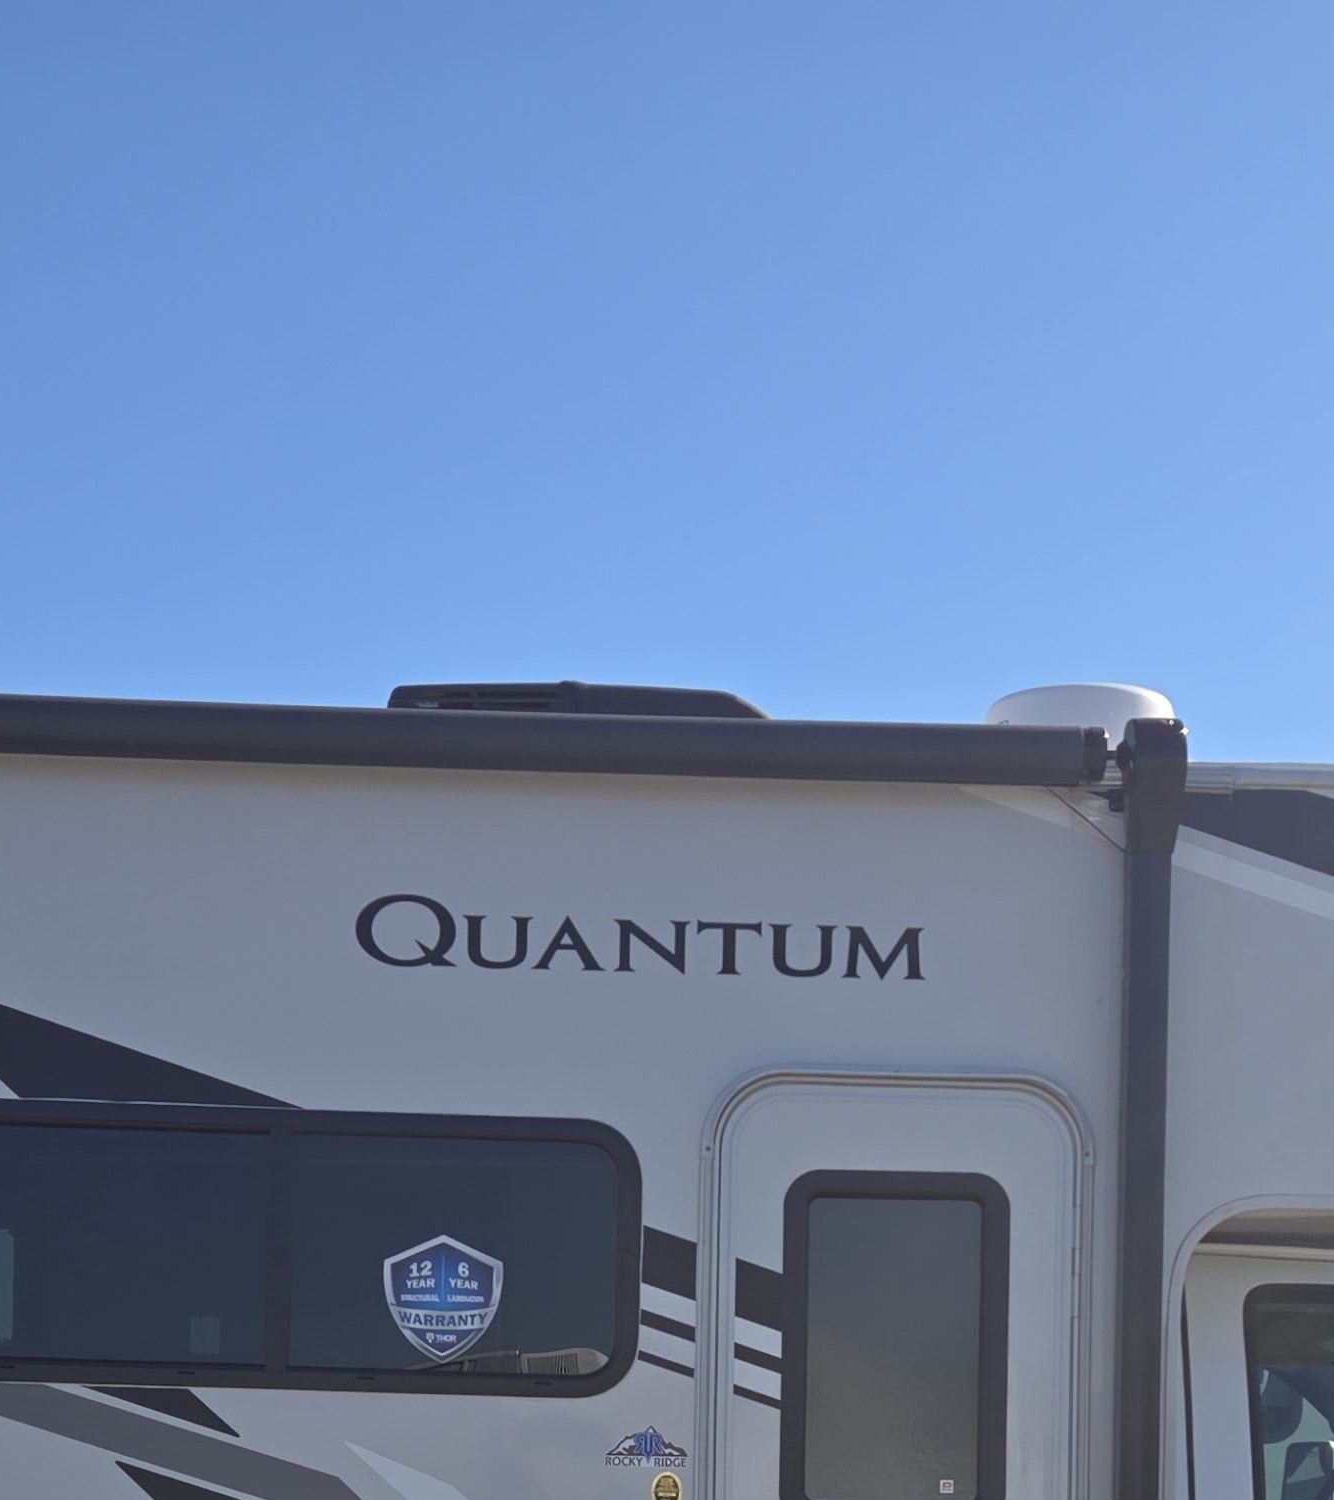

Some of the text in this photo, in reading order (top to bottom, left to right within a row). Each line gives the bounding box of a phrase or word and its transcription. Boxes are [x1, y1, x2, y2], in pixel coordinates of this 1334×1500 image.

[355, 893, 926, 981] QUANTUM
[409, 1261, 470, 1278] 12 6
[406, 1278, 479, 1291] YEAR YEAR
[397, 1311, 489, 1327] WARRANTY
[435, 1334, 457, 1343] THOR
[605, 1456, 687, 1468] ROCKY RIDGE
